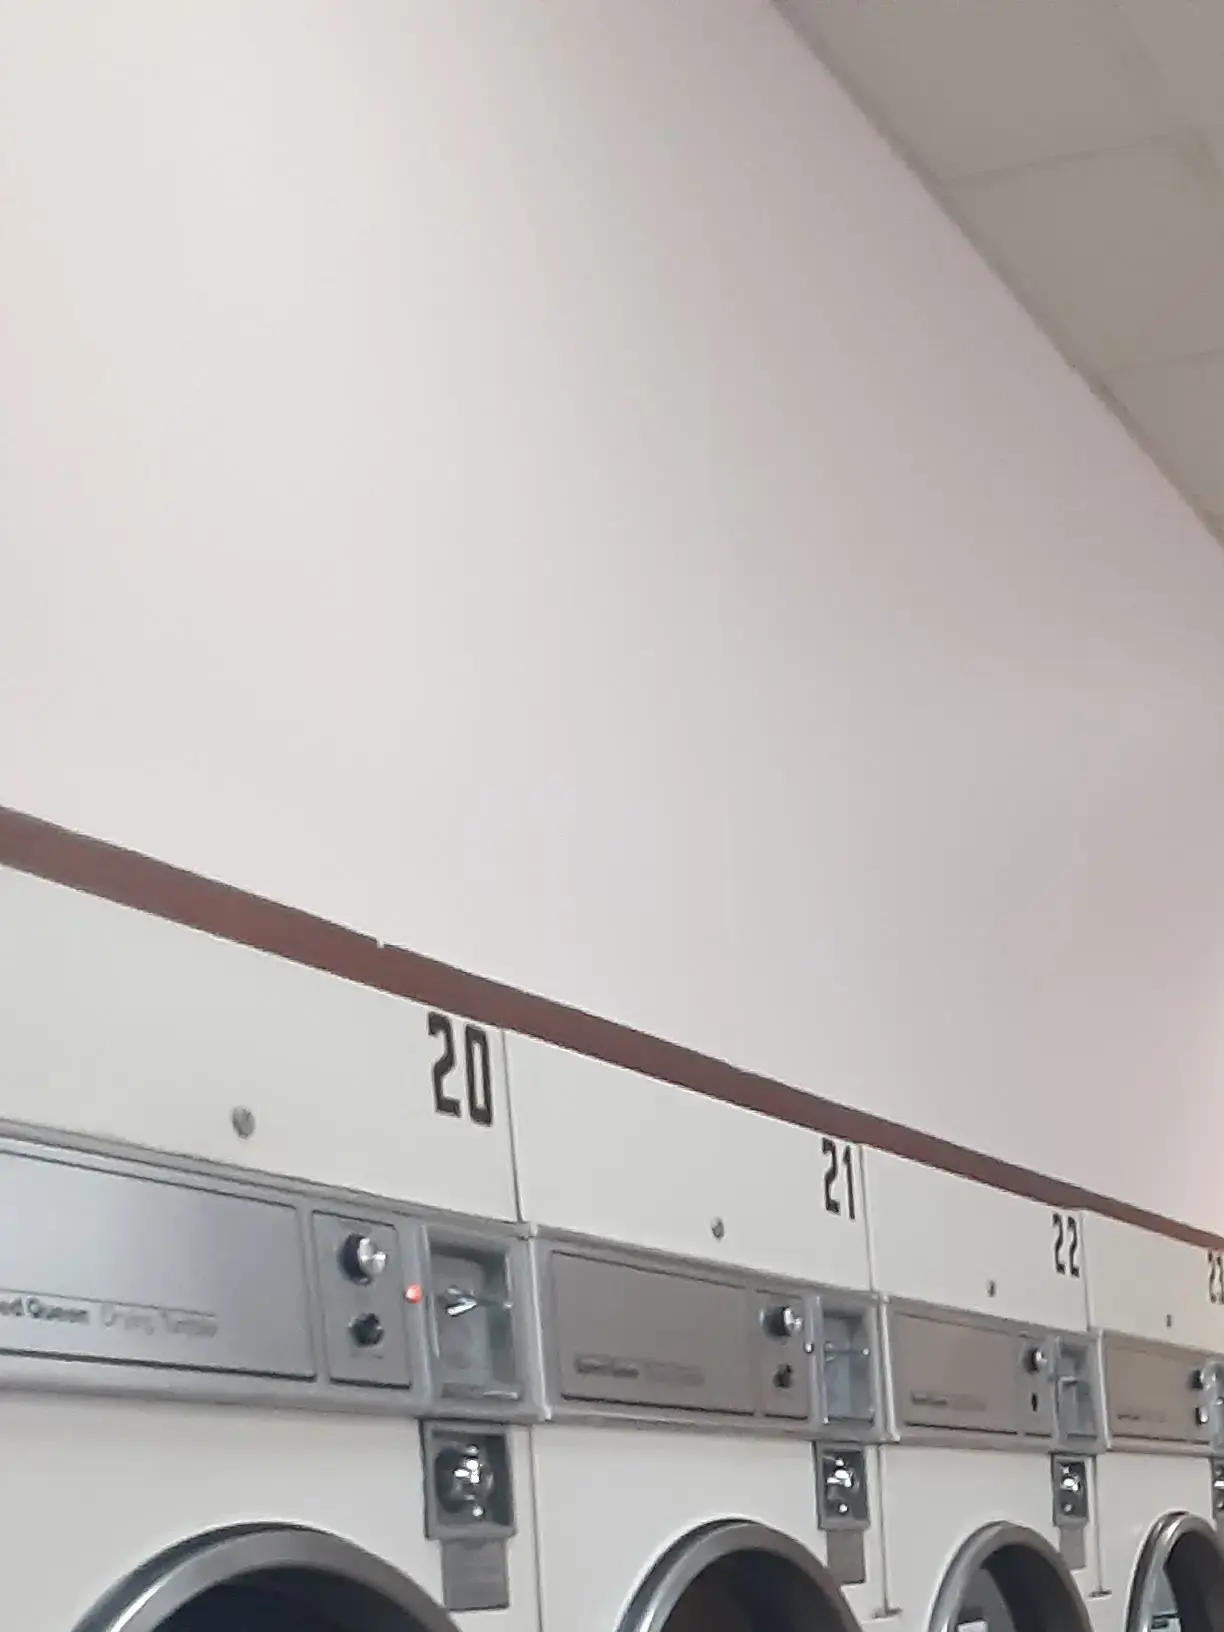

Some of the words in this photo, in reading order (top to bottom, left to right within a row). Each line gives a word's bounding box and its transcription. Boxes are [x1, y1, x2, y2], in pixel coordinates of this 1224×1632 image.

[427, 1011, 494, 1128] 20
[821, 1136, 857, 1222] 21
[1051, 1211, 1081, 1279] 22
